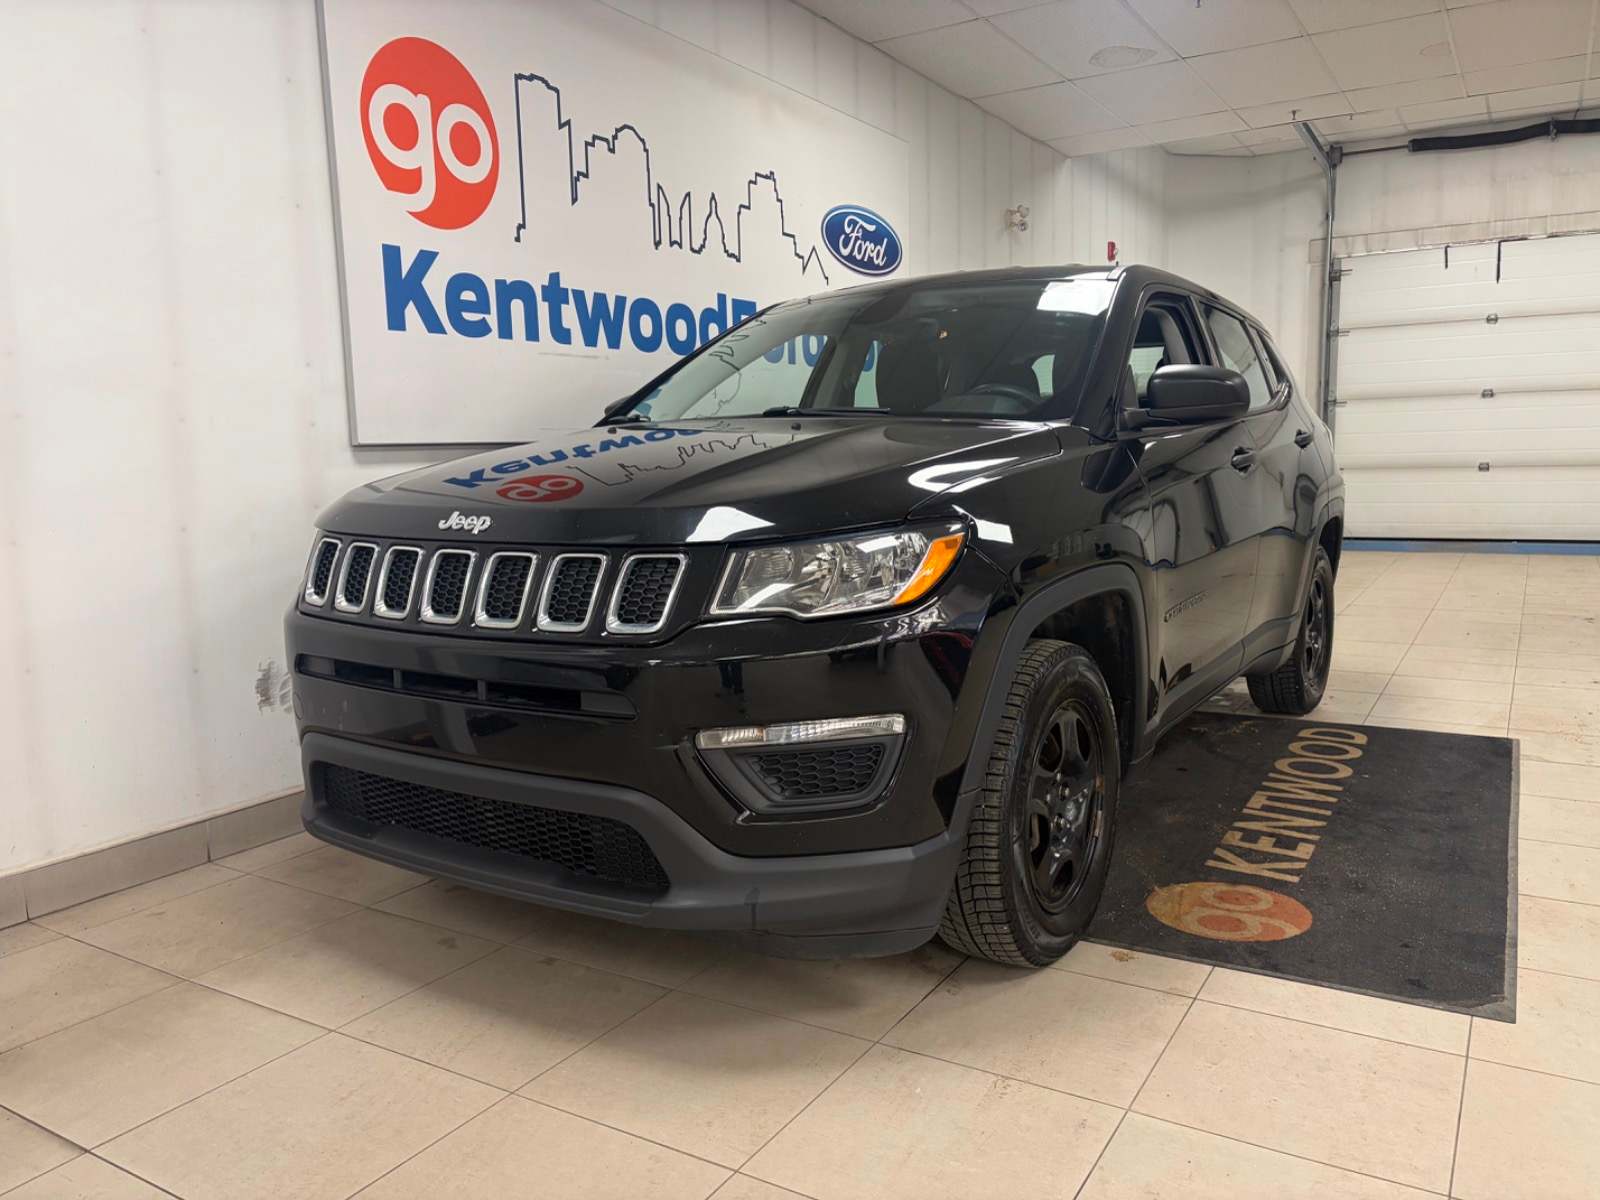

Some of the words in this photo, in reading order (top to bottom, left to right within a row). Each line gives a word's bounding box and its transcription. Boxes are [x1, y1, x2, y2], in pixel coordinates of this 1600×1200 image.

[368, 83, 493, 214] go
[839, 214, 887, 268] Ford
[438, 510, 492, 534] Jeep
[1204, 727, 1369, 883] KENTWOOD
